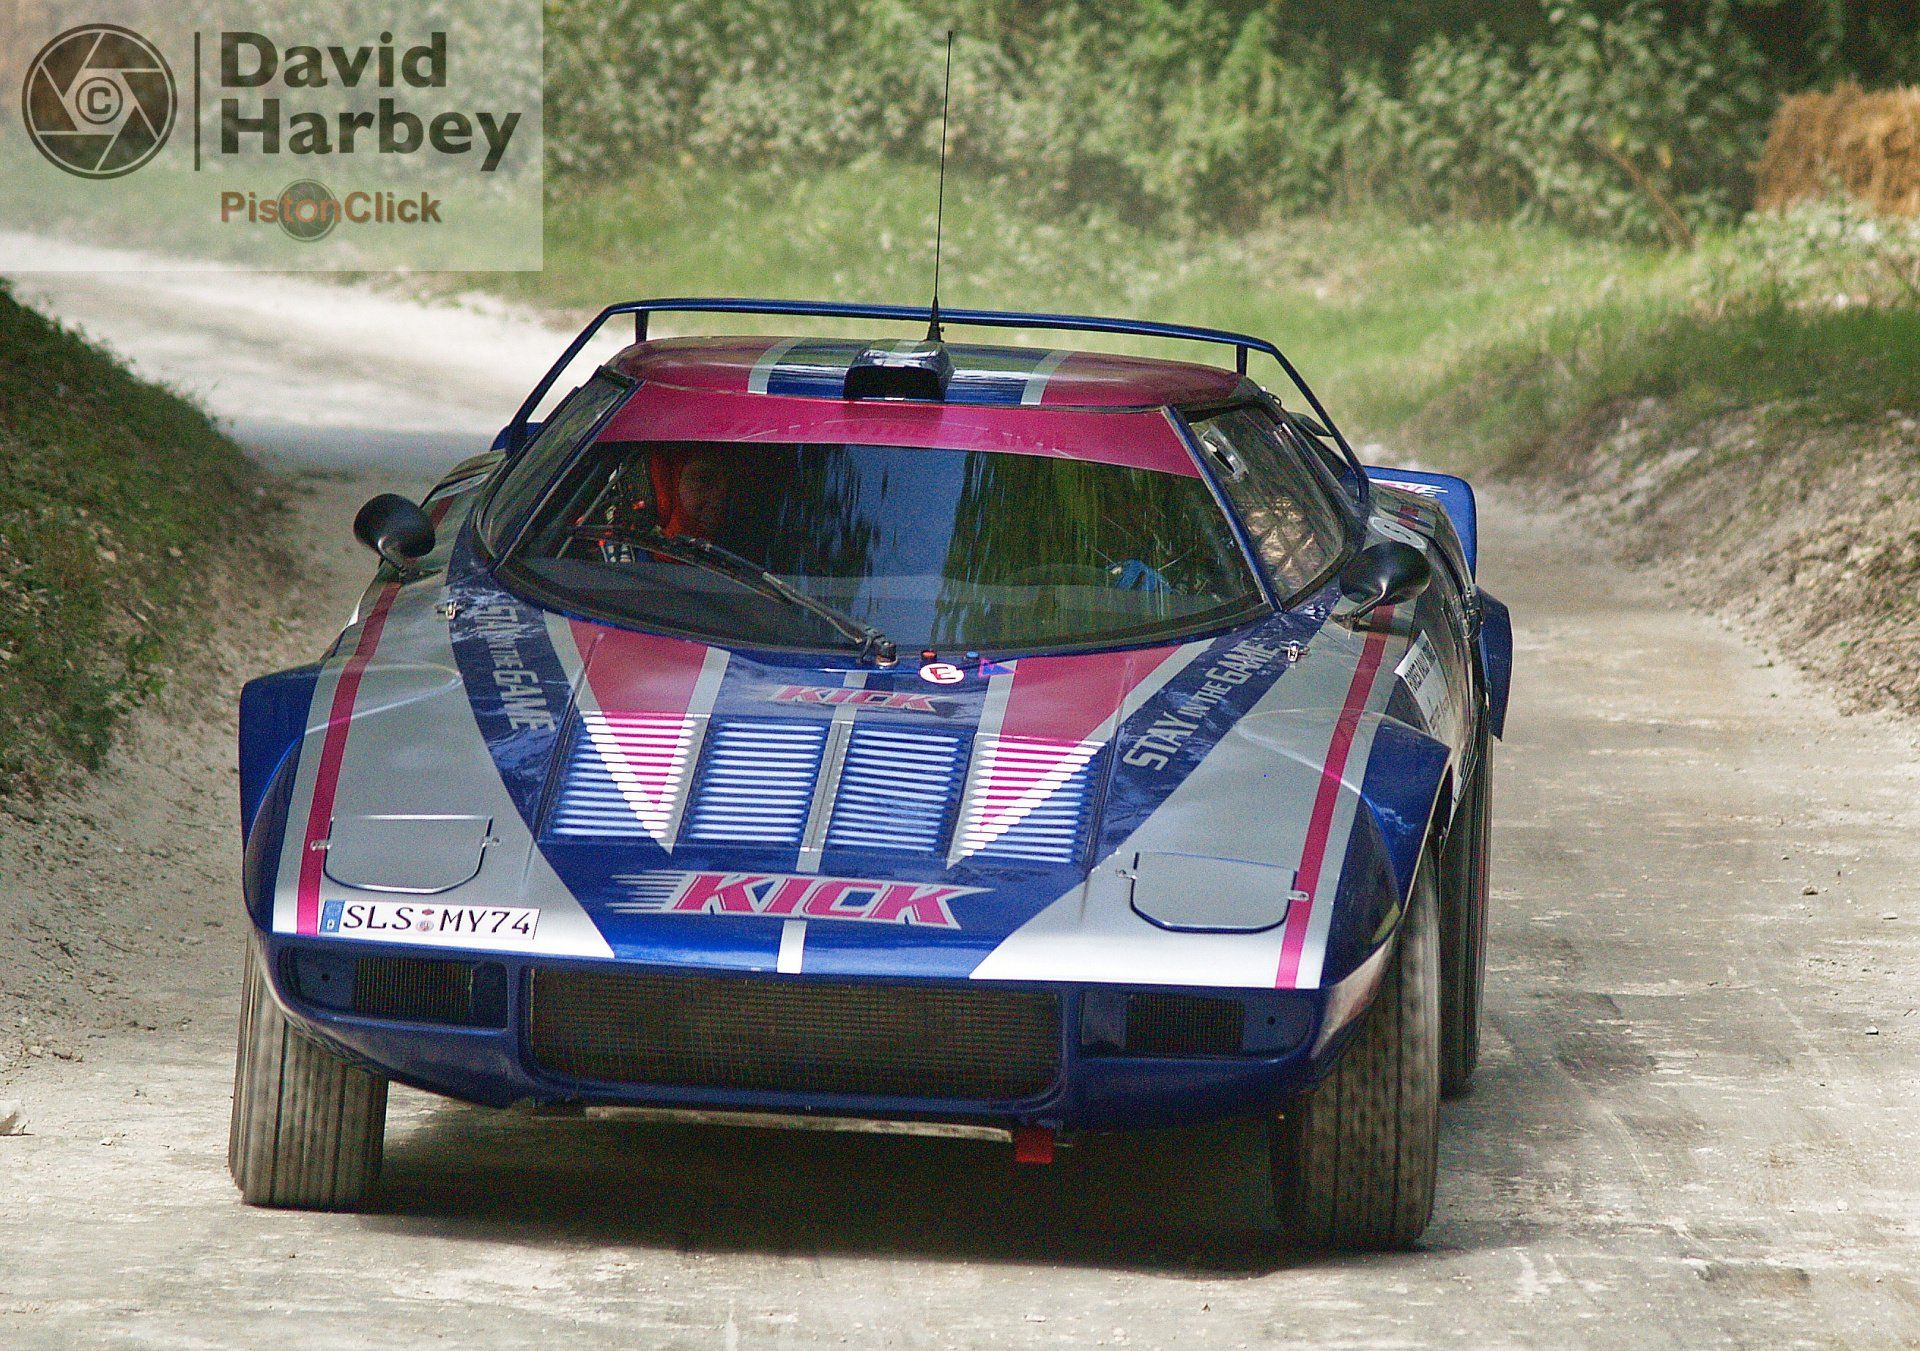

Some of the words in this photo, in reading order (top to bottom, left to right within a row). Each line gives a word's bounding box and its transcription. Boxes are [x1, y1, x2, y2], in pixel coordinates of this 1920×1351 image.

[1205, 640, 1280, 685] GAME
[491, 669, 556, 732] GAME
[772, 685, 938, 713] KICK
[1177, 702, 1211, 718] IN
[1193, 680, 1233, 704] THE
[1121, 711, 1200, 771] STAY
[664, 871, 978, 929] KICK
[343, 905, 414, 930] SLS
[439, 908, 531, 935] MY74
